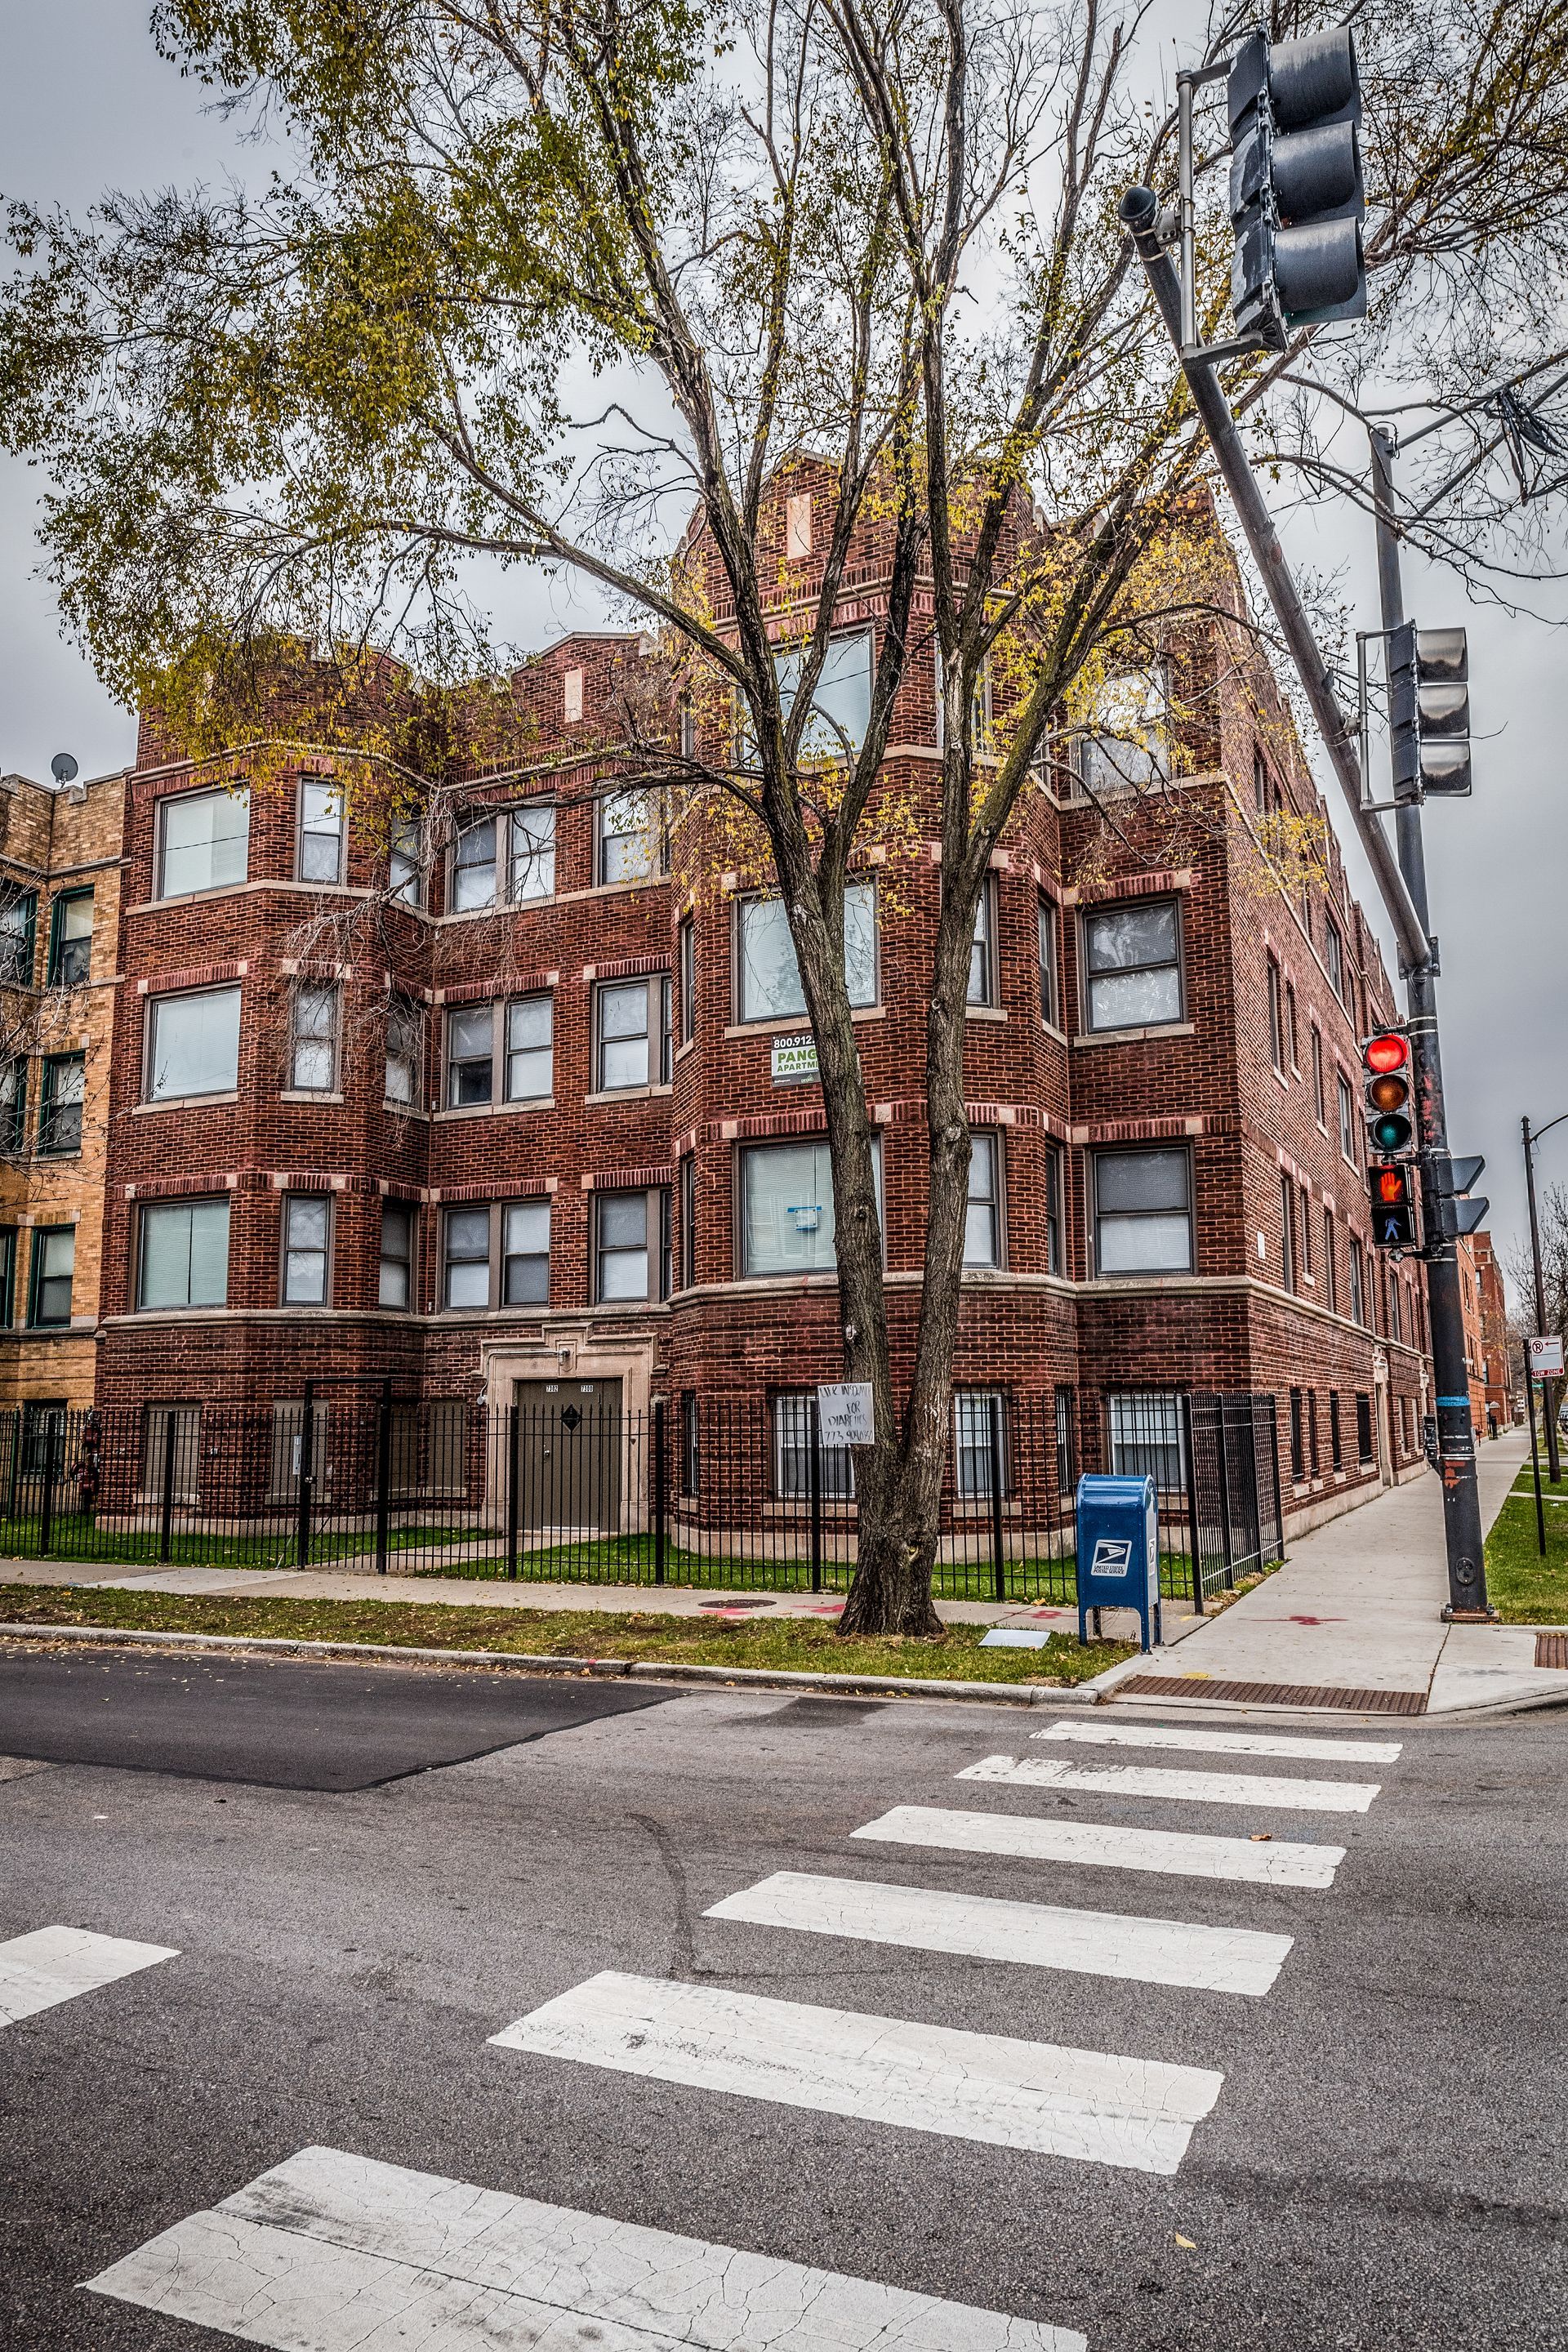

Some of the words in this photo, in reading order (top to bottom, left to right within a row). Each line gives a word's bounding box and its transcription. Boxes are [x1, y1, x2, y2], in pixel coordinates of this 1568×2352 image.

[846, 1401, 861, 1414] FOR
[828, 1414, 867, 1427] DIABETICS
[825, 1431, 844, 1443] 773
